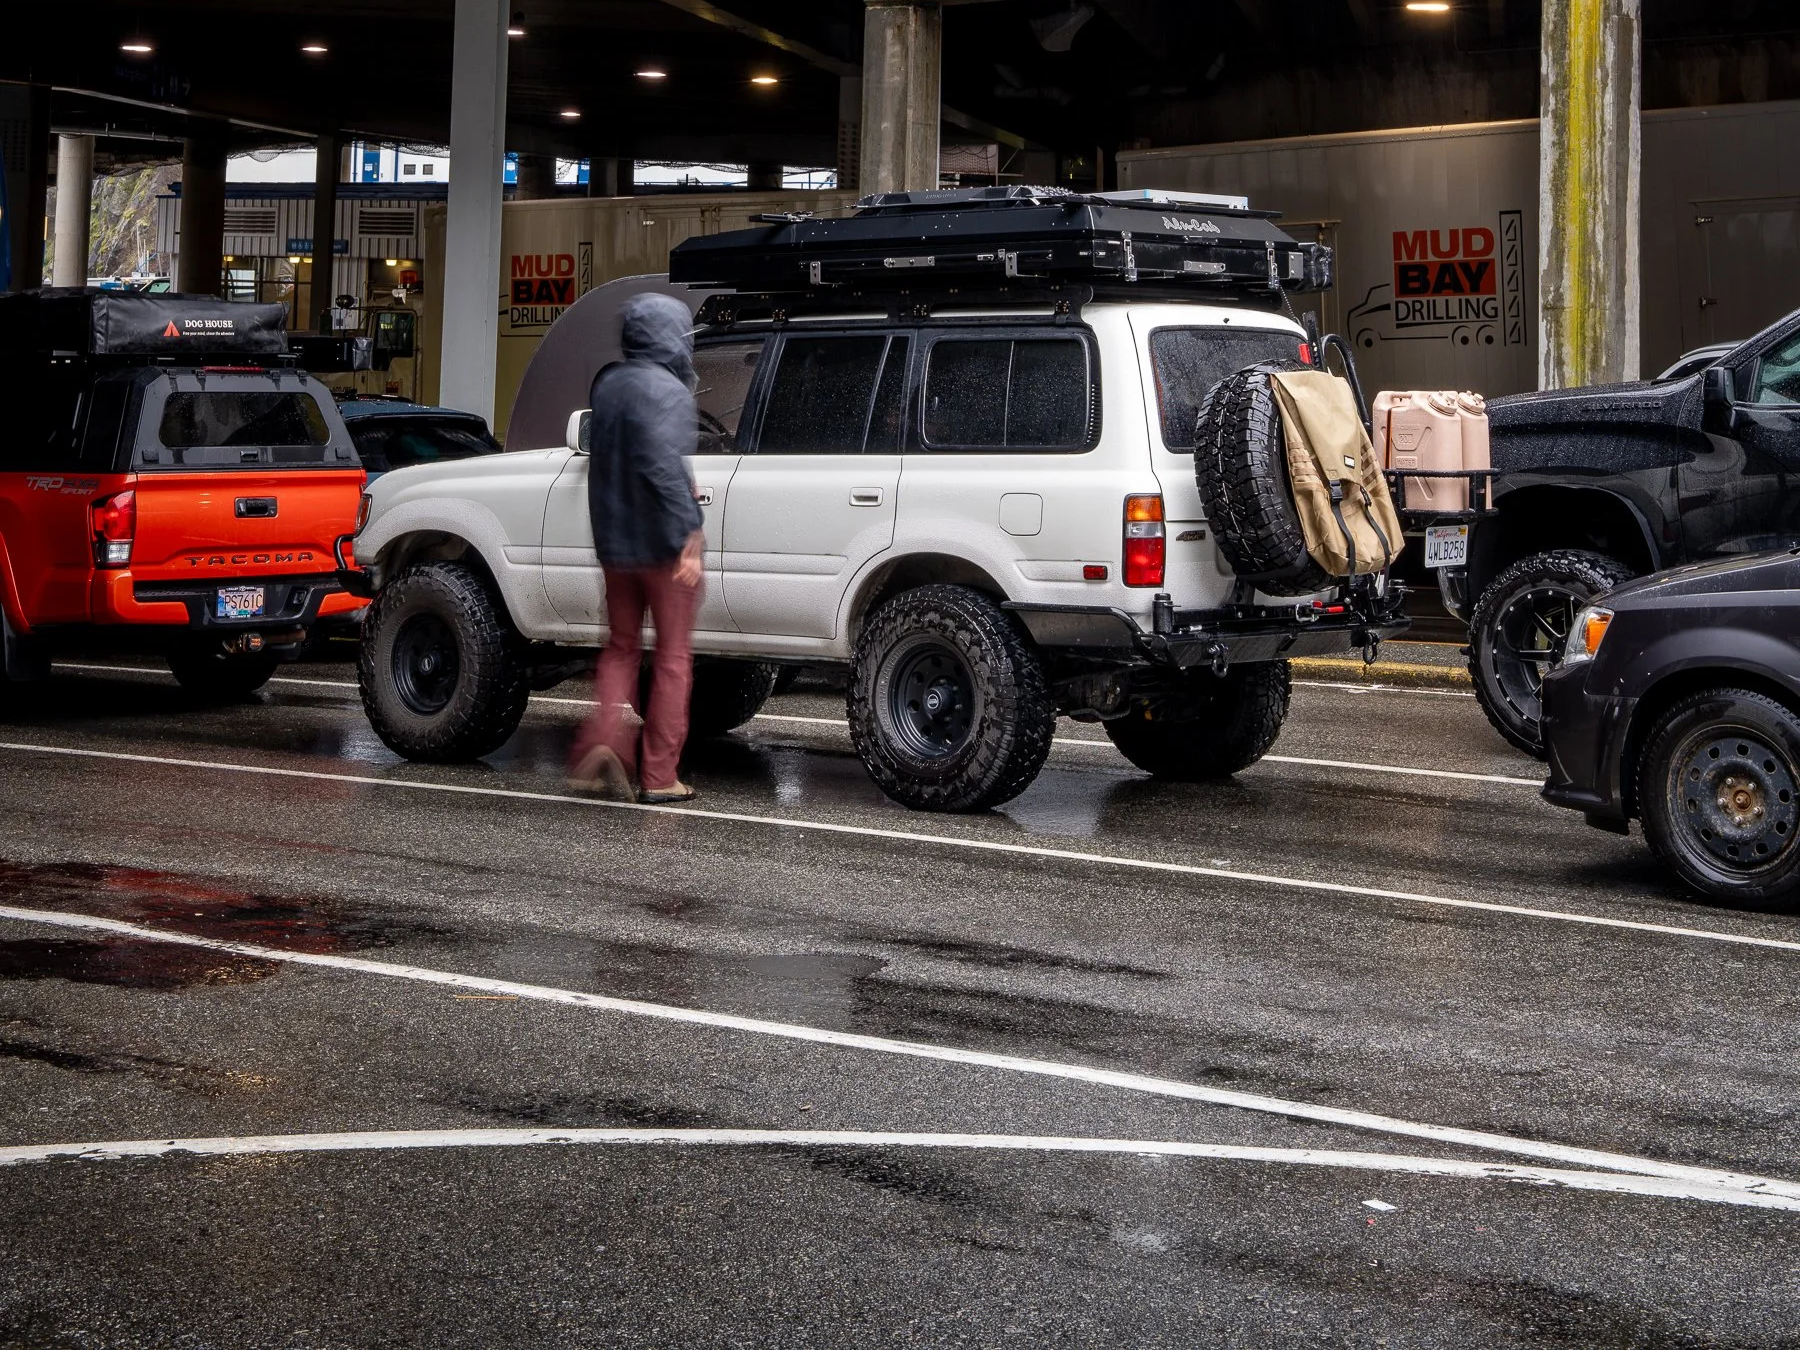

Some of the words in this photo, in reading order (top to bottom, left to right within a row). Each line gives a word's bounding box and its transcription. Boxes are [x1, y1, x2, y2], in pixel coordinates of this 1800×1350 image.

[1393, 227, 1495, 261] MUD
[511, 254, 575, 278] MUD
[1398, 261, 1490, 295] BAY
[513, 279, 573, 304] BAY
[510, 306, 565, 324] DRILLIN
[1394, 297, 1499, 322] DRILLING
[185, 320, 203, 328] DOG
[205, 320, 233, 328] HOUSE
[1582, 401, 1662, 411] SILVERADO
[1397, 458, 1416, 467] WATER
[26, 476, 65, 491] TRD
[184, 552, 314, 567] TACOMA
[1428, 541, 1465, 562] 4WLB258
[224, 594, 263, 610] PS761C
